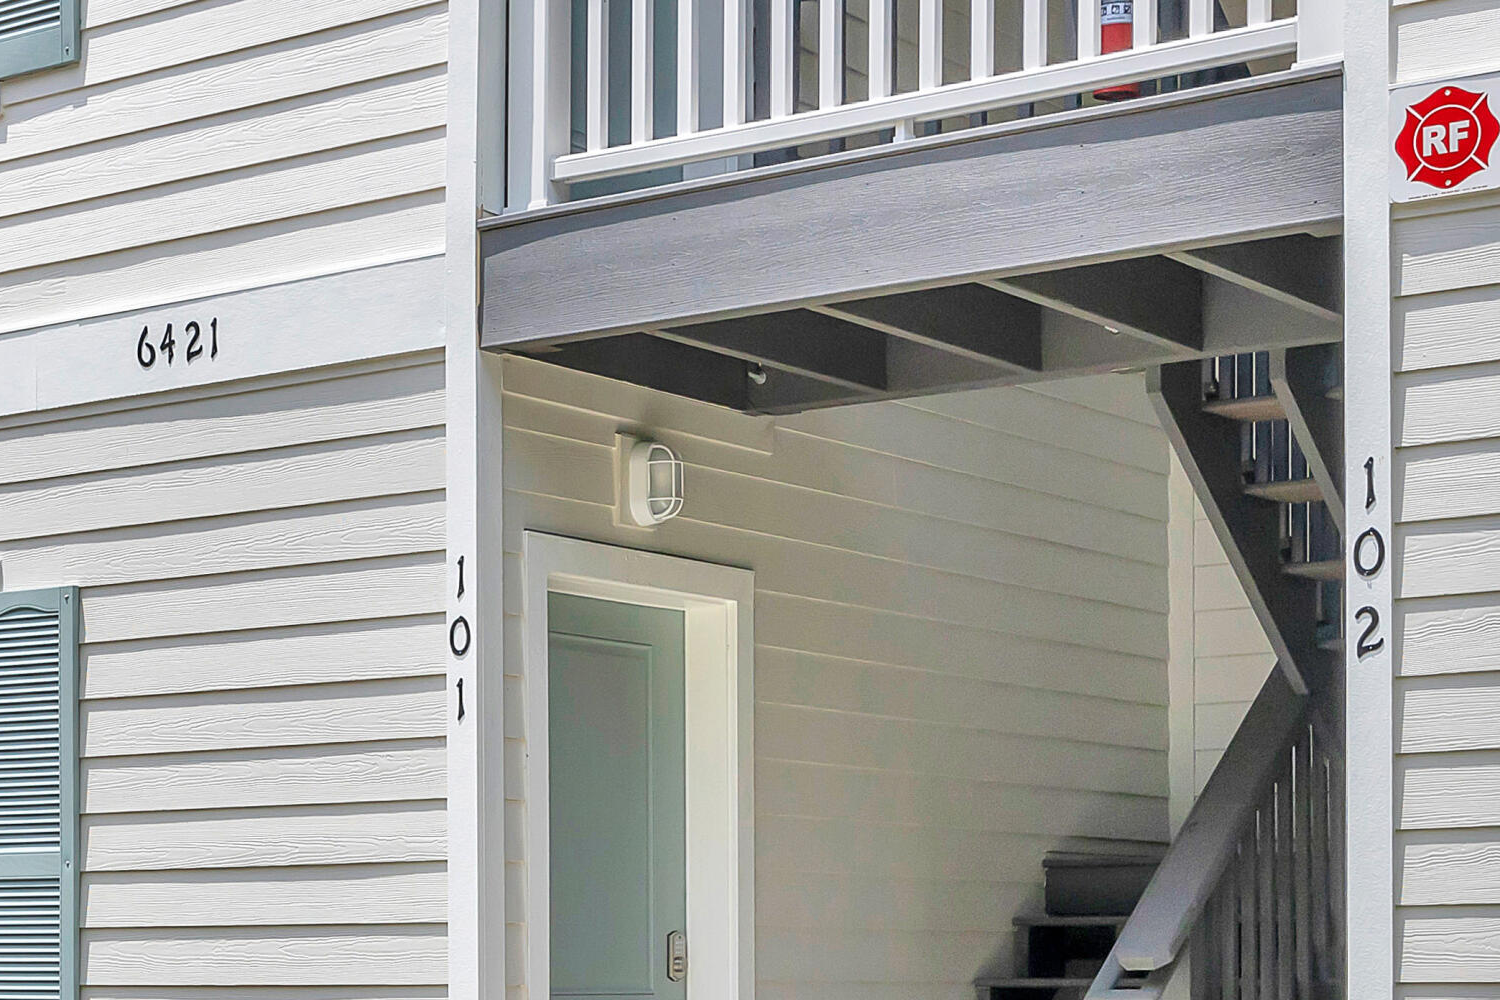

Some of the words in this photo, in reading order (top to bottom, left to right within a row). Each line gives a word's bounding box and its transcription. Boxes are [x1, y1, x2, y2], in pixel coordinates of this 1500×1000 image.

[1422, 119, 1470, 157] RF
[137, 317, 218, 368] 6421
[1353, 456, 1386, 659] 102
[449, 555, 471, 721] 101
